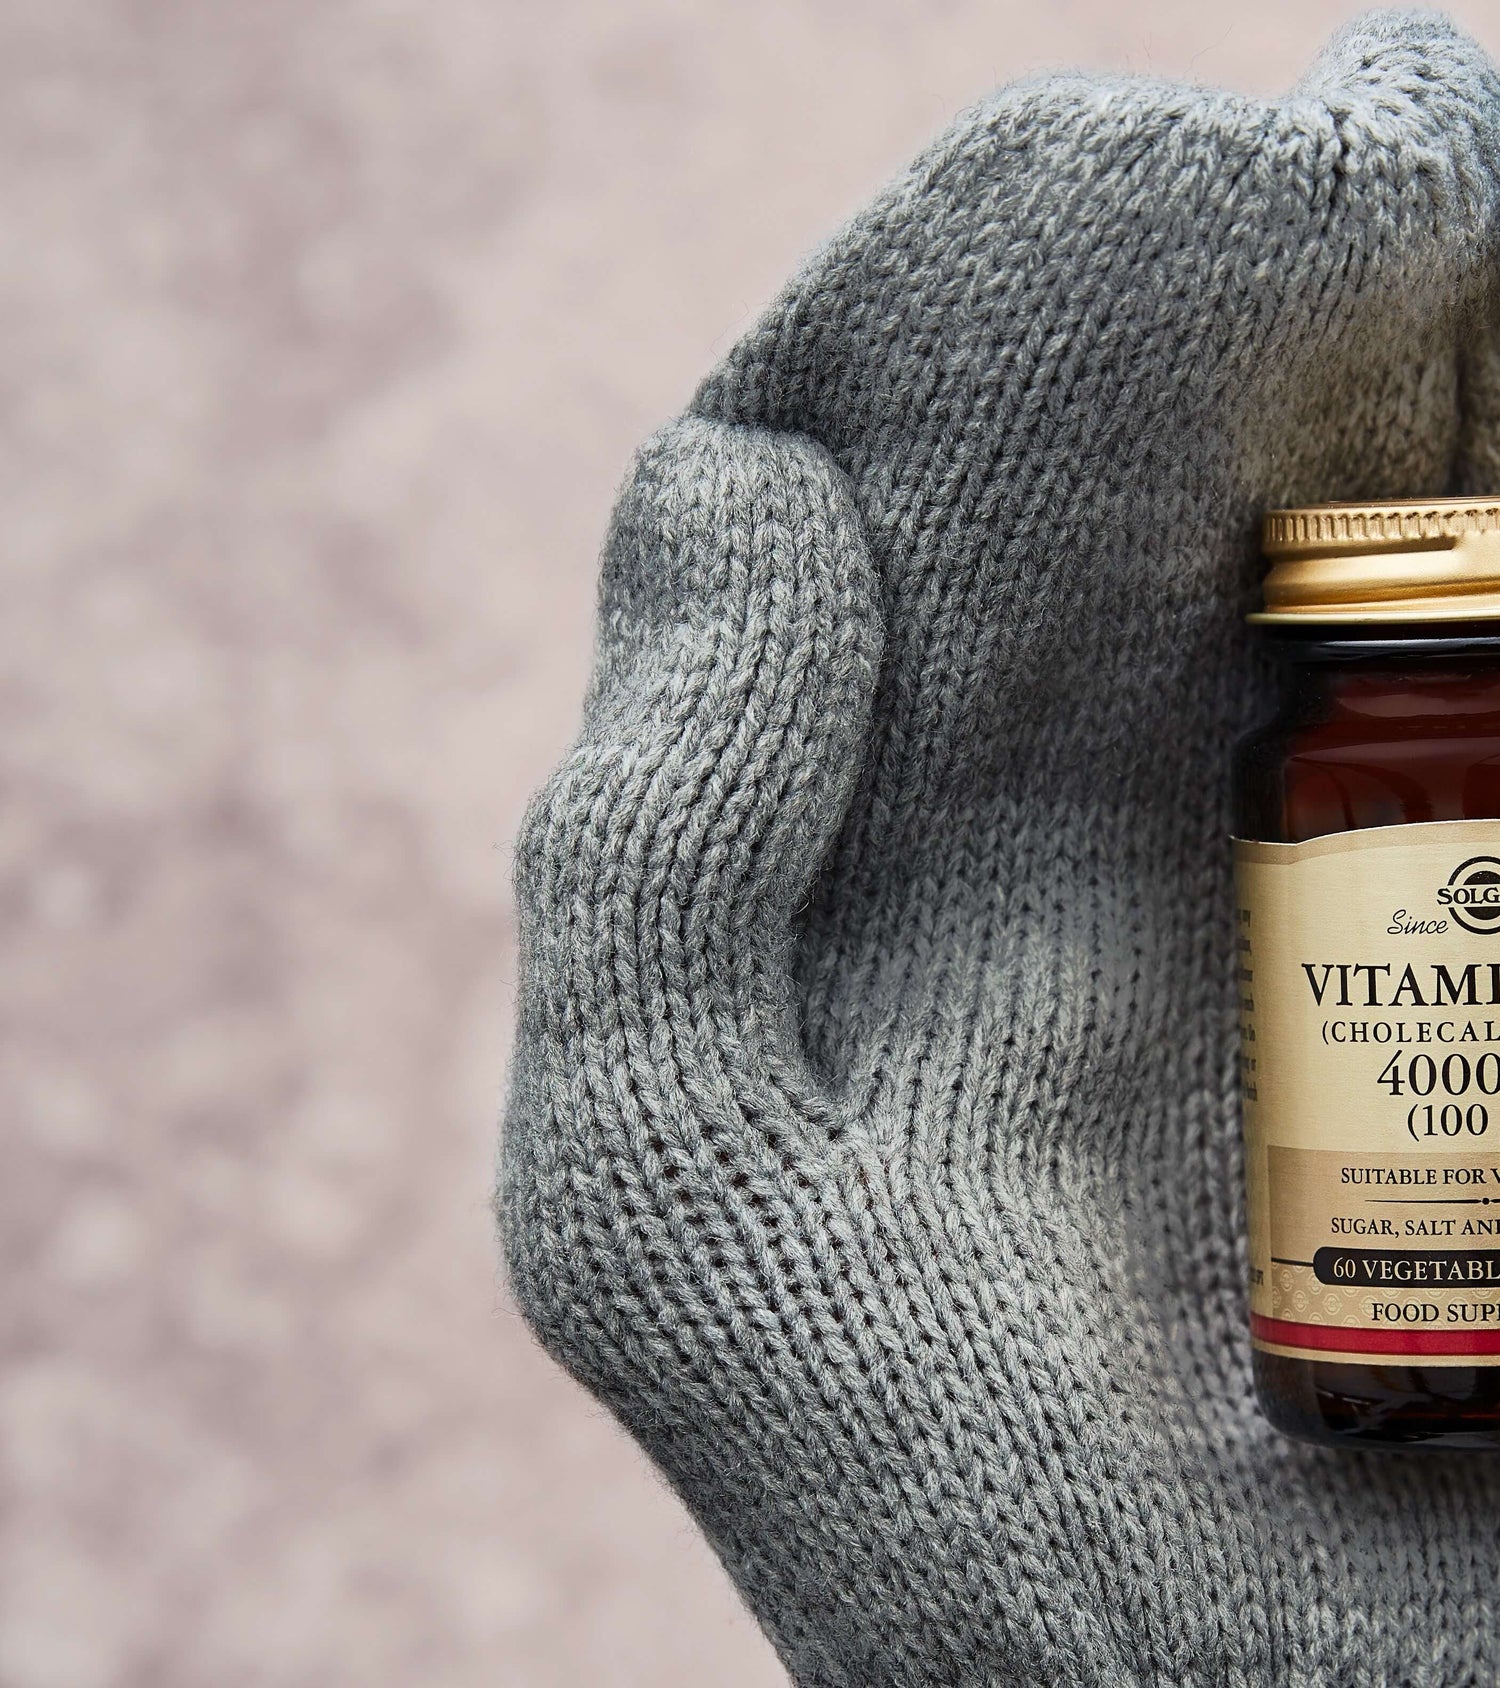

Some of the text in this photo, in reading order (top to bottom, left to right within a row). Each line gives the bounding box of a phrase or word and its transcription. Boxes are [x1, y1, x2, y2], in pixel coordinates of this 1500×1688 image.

[1386, 909, 1449, 935] Since
[1407, 1103, 1489, 1142] (100
[1341, 1166, 1437, 1186] SUITABLE
[1442, 1168, 1488, 1185] FOR
[1331, 1217, 1400, 1239] SUGAR,
[1404, 1219, 1457, 1236] SALT
[1333, 1257, 1356, 1279] 60
[1371, 1302, 1440, 1323] FOOD
